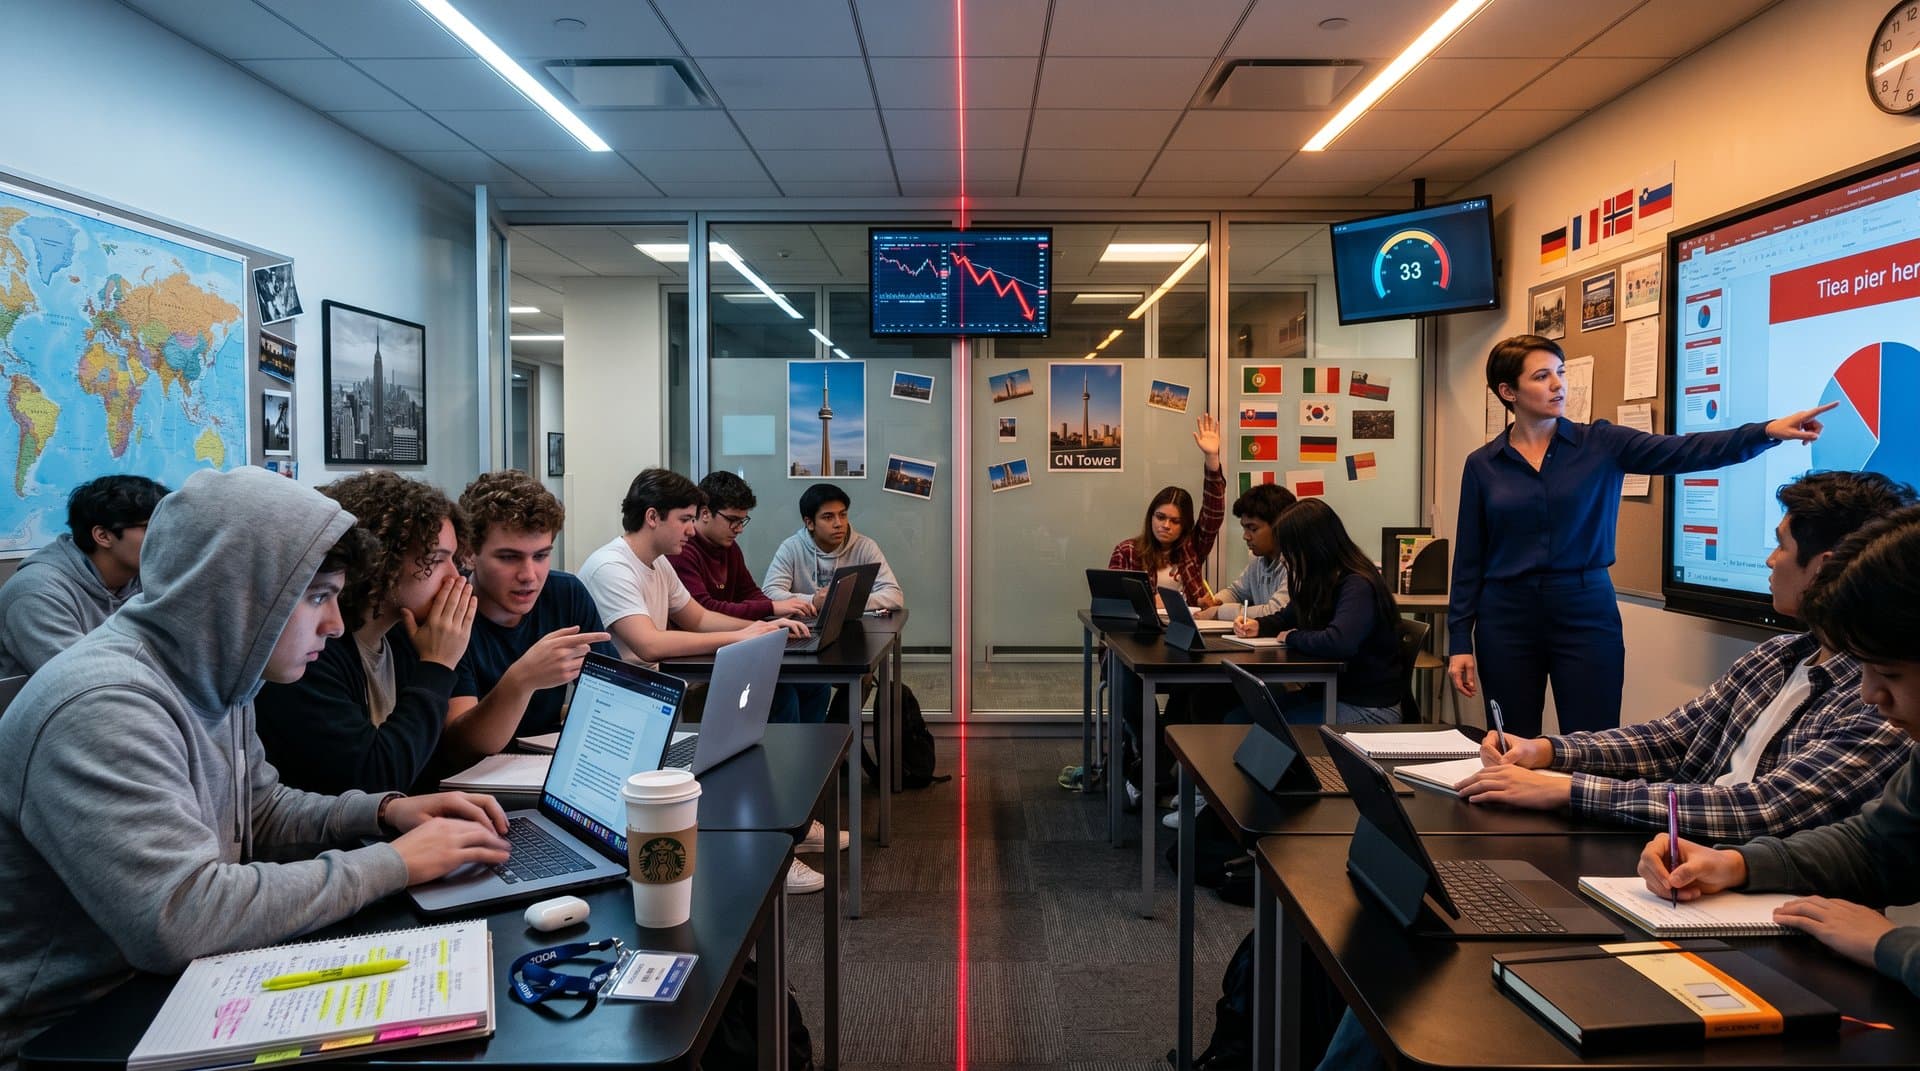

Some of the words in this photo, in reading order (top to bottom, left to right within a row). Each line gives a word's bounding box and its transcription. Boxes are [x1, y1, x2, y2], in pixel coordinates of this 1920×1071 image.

[1907, 7, 1918, 21] 12
[1892, 21, 1900, 33] 11
[1881, 39, 1893, 54] 10
[1881, 80, 1889, 93] 8
[1893, 89, 1900, 102] 7
[1906, 89, 1914, 102] 6
[1399, 261, 1422, 281] 33
[1816, 277, 1849, 299] Tiea
[1854, 269, 1887, 296] pier
[1055, 454, 1073, 466] CN
[1076, 454, 1117, 466] Tower
